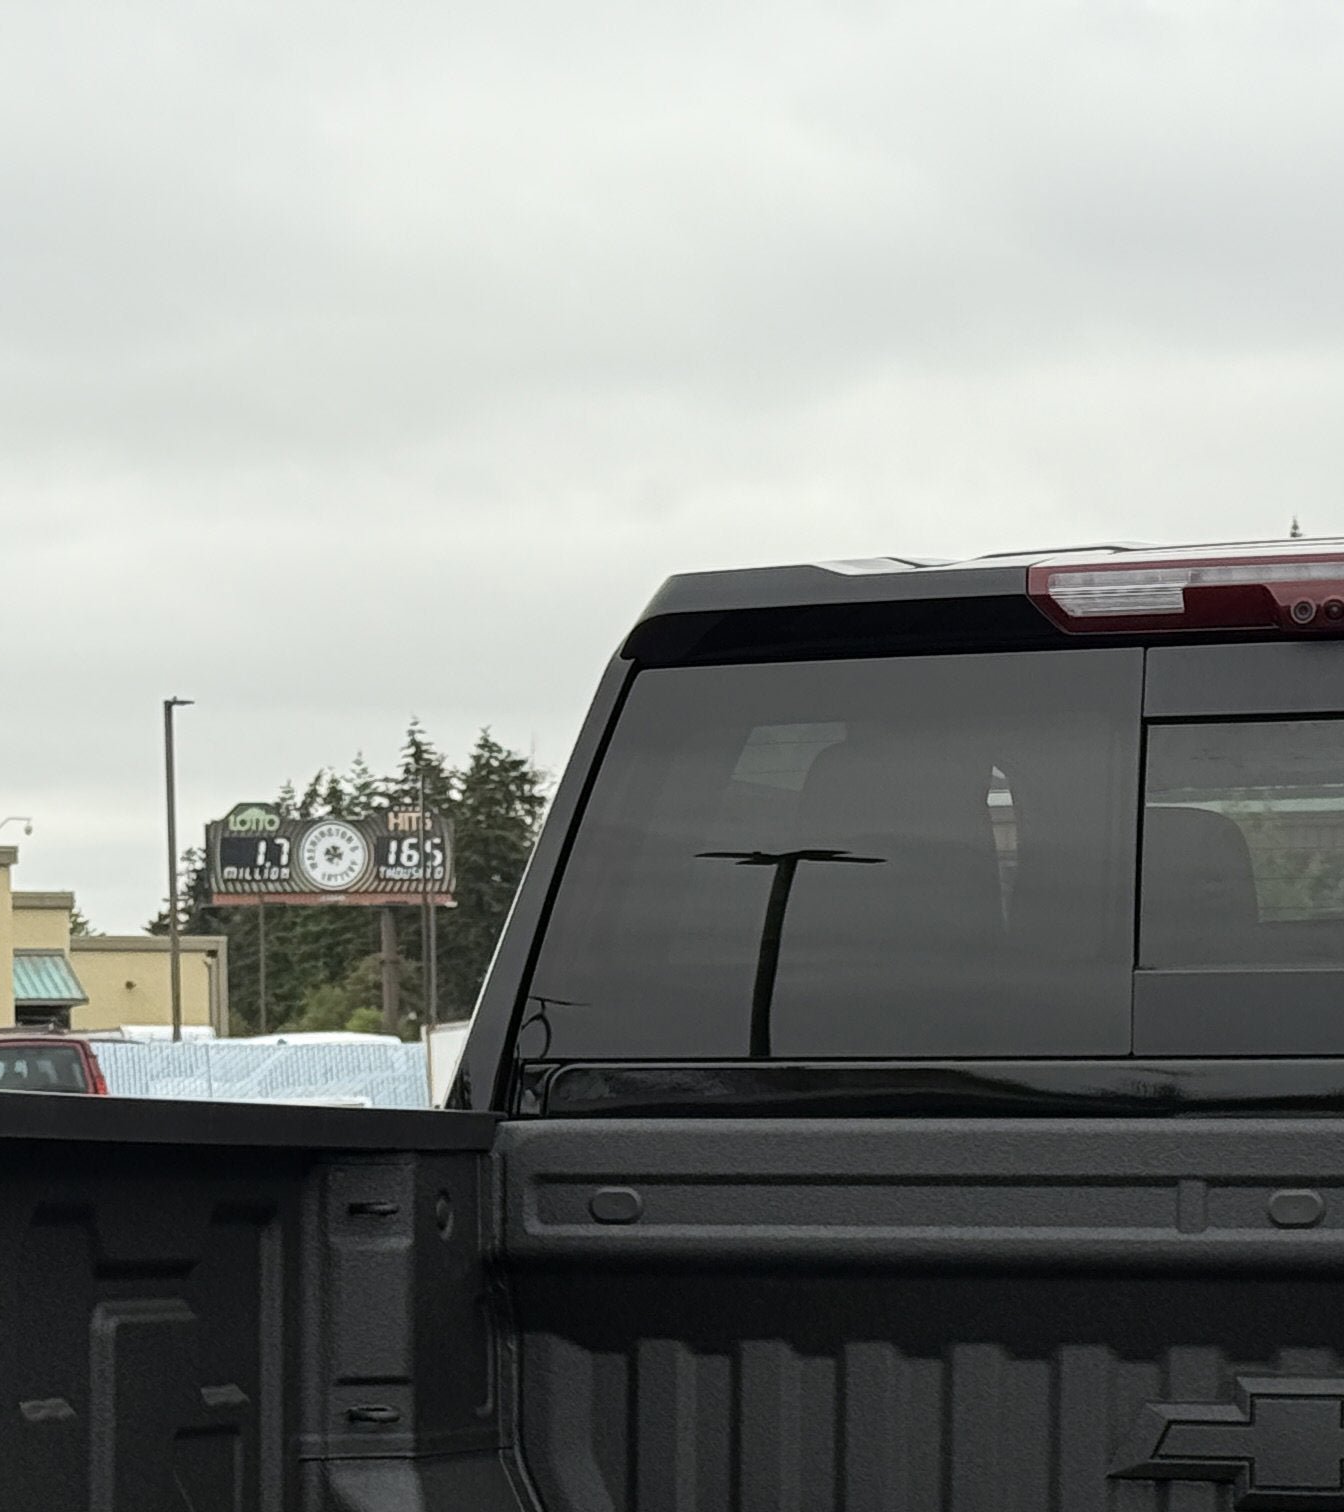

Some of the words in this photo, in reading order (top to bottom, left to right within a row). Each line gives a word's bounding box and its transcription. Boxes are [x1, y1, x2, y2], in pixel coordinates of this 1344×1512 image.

[229, 810, 281, 831] LOTTO
[256, 838, 290, 868] 1.7
[388, 837, 443, 866] 165
[223, 866, 290, 880] MILLION
